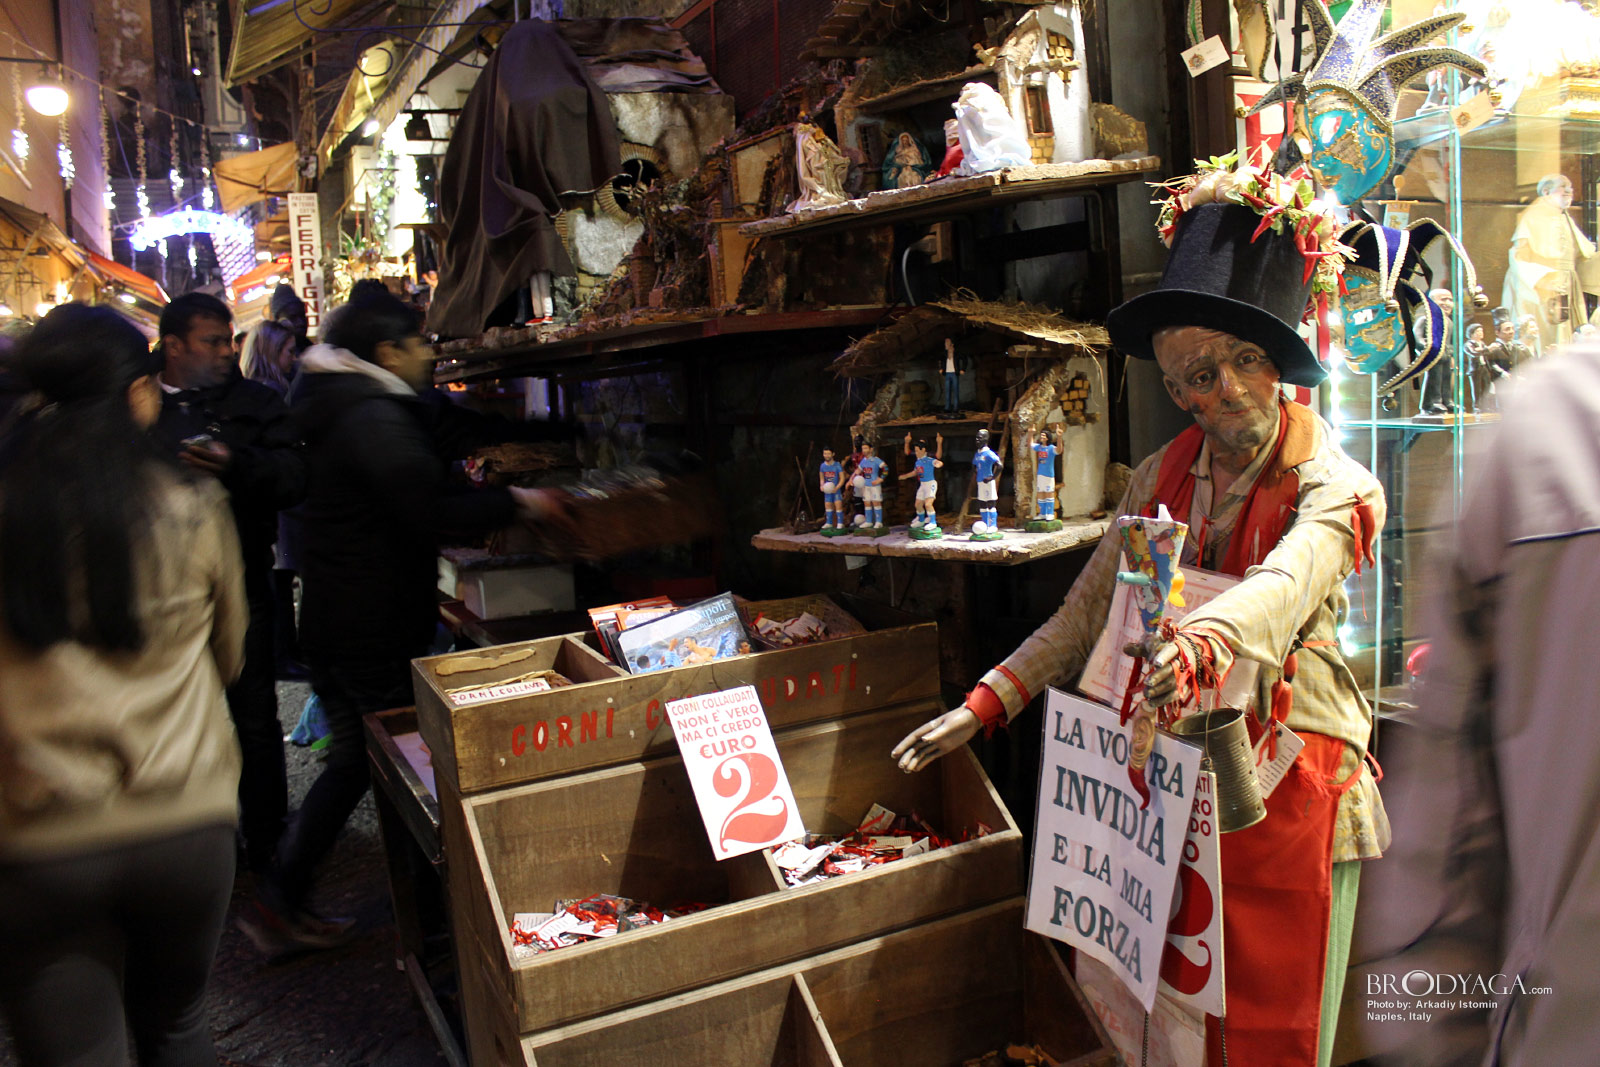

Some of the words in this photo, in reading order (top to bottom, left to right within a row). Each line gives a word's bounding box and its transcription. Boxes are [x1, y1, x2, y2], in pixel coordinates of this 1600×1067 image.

[671, 701, 700, 716] CORNI
[702, 690, 755, 710] COLLAUDATI
[677, 715, 709, 730] NON
[725, 703, 759, 719] VERO
[682, 730, 703, 743] MA
[706, 726, 718, 738] CI
[721, 717, 762, 734] CREDO
[700, 735, 757, 759] €URO
[1053, 710, 1086, 750] LA
[1096, 725, 1185, 798] VORA
[712, 752, 788, 853] 2
[1053, 764, 1166, 867] INVIDIA
[1051, 832, 1068, 865] E
[1083, 844, 1112, 887] LA
[1120, 867, 1153, 924] MIA
[1050, 885, 1142, 984] FORZA
